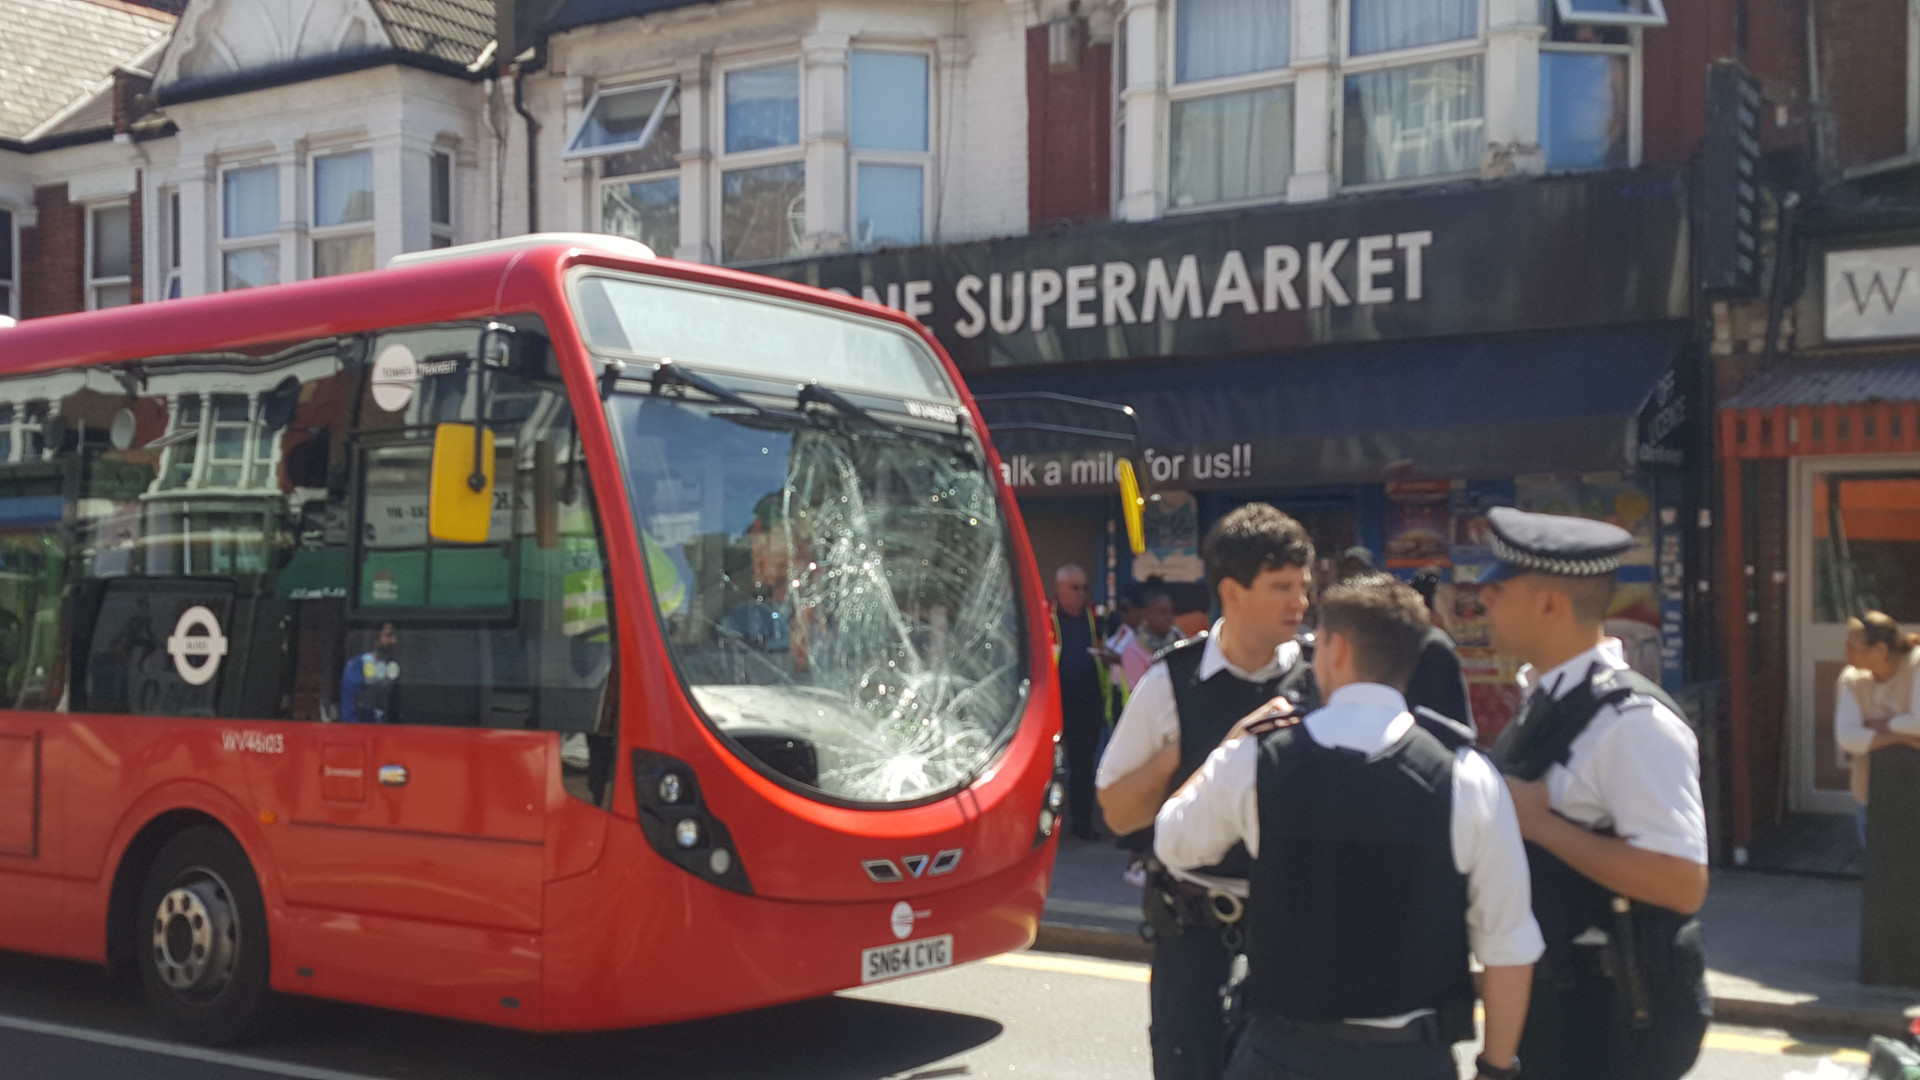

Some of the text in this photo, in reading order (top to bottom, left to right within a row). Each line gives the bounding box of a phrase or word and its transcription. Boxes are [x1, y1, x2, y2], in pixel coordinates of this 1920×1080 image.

[826, 279, 934, 336] NE
[954, 230, 1433, 339] SUPERMARKET
[1043, 460, 1062, 486] a
[1192, 443, 1252, 480] us!!
[868, 939, 946, 977] SN64 CVG
